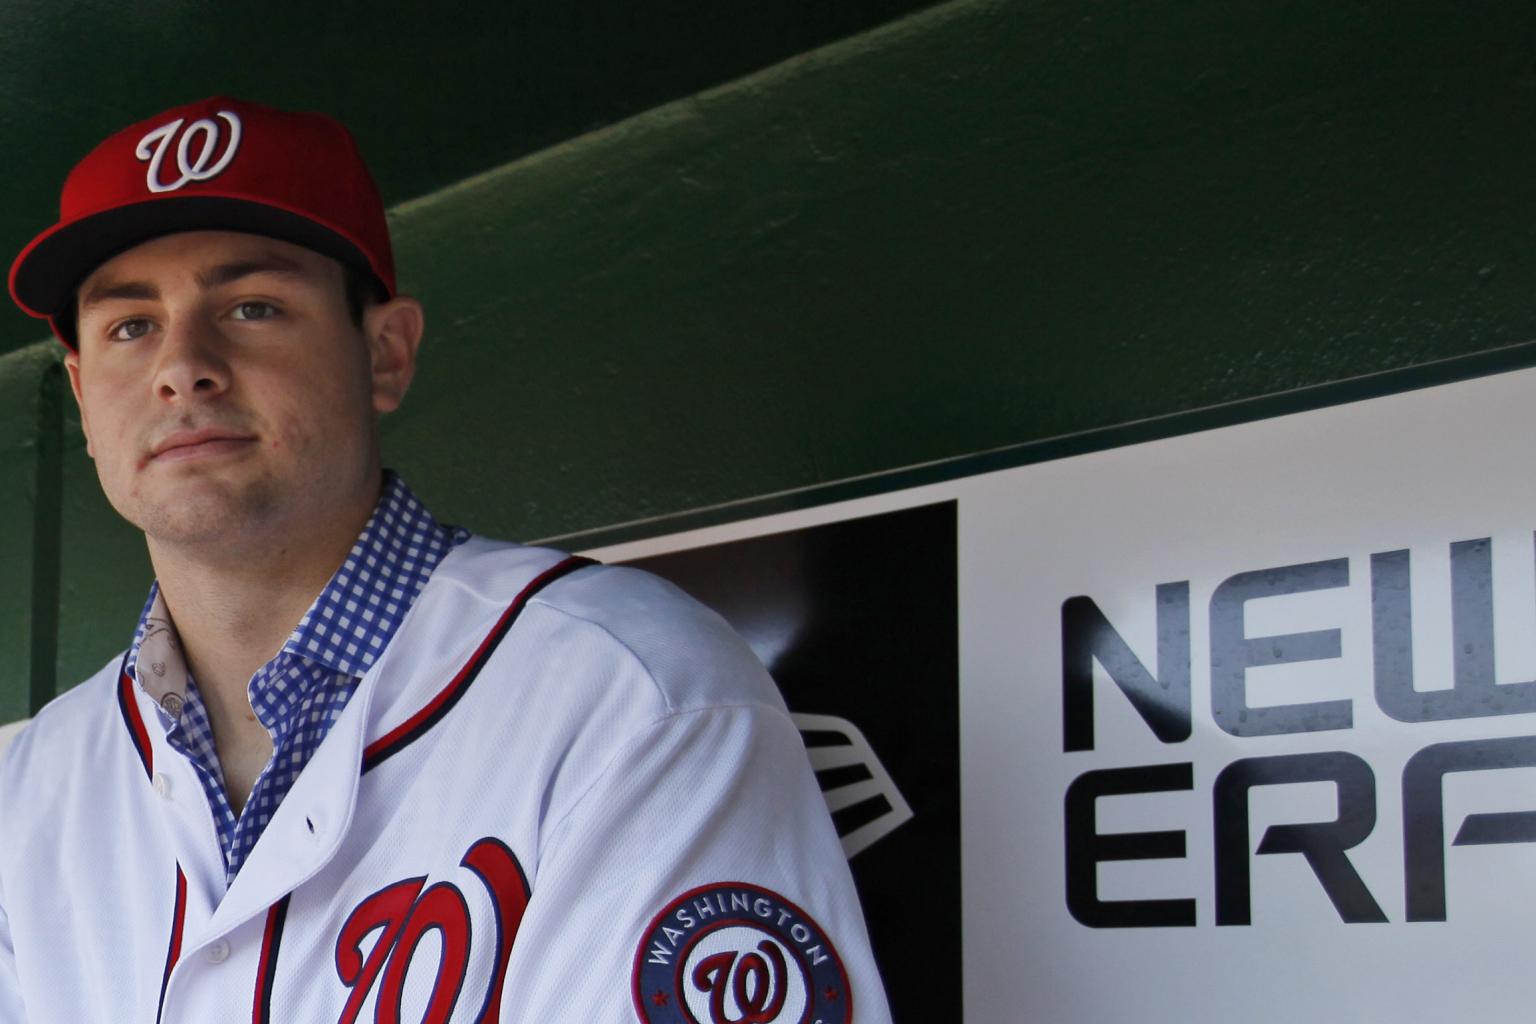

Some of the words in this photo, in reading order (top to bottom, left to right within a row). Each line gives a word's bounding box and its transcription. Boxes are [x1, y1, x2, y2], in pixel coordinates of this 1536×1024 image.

[135, 111, 243, 194] W
[1061, 530, 1536, 753] NEW
[648, 892, 829, 966] WASHINGTON
